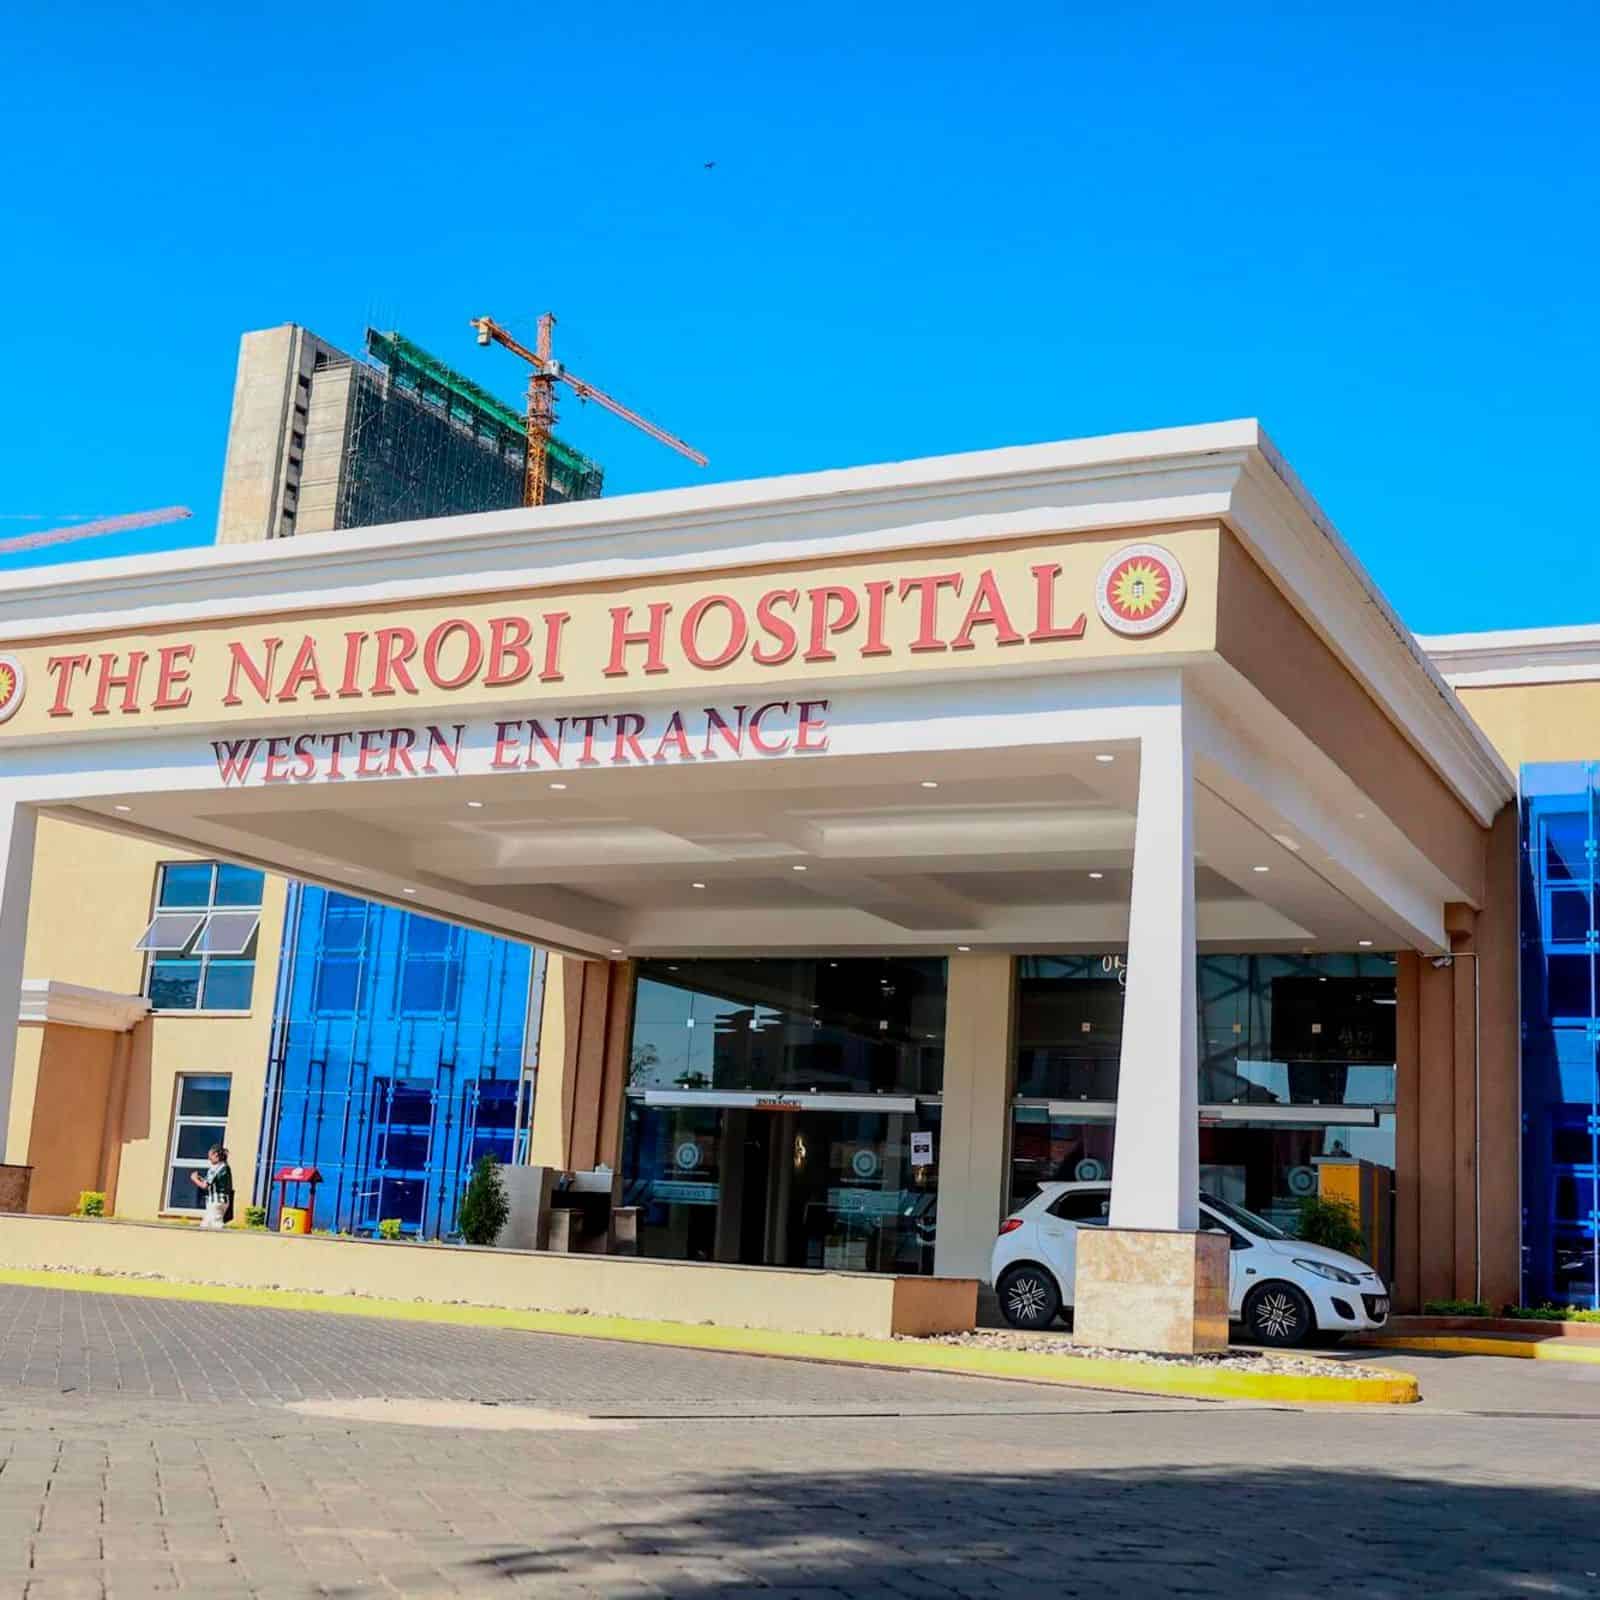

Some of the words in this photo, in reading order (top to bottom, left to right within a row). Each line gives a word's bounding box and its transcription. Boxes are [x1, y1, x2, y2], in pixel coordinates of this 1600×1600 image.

[47, 643, 193, 718] THE
[223, 610, 571, 706] NAIROBI
[603, 562, 1086, 677] HOSPITAL
[211, 724, 465, 788] WESTERN
[491, 699, 830, 772] ENTRANCE
